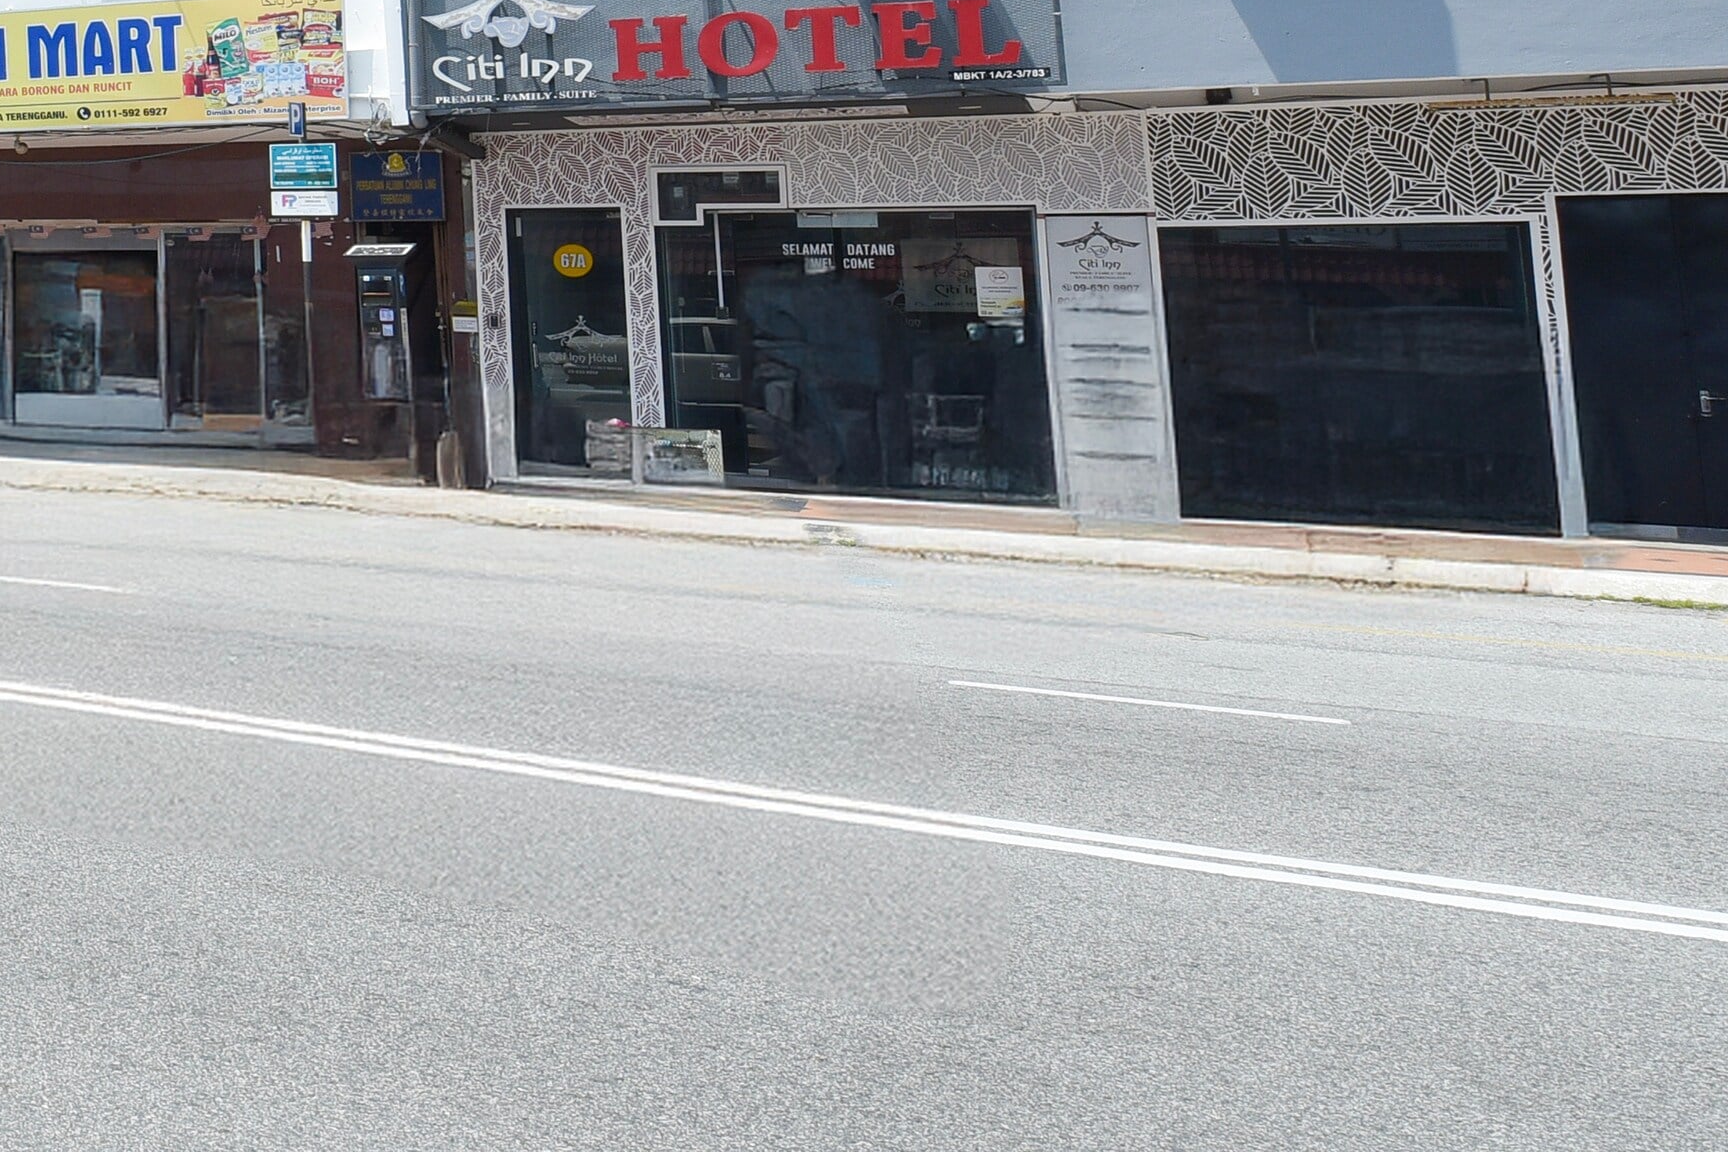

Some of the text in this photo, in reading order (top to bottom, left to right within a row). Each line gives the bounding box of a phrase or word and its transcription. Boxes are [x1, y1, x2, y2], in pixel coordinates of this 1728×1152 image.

[214, 29, 237, 42] MILO
[27, 15, 182, 80] MART
[432, 52, 593, 92] Citi Inn
[953, 69, 1045, 81] MBKT 1A/2-3/783
[313, 75, 337, 85] BOH
[22, 84, 65, 96] BORONG
[68, 84, 89, 93] DAN
[93, 81, 133, 92] RUNCIT
[435, 89, 597, 104] PREMIER FAMILY SUITE
[6, 111, 68, 121] TERENGGANU.
[94, 108, 140, 119] 0111-592
[143, 107, 168, 117] 6927
[206, 108, 235, 116] Dimiliki
[237, 107, 256, 115] Oleh
[291, 104, 301, 134] P
[782, 243, 895, 256] SELAMAT DATANG
[560, 253, 587, 268] 67A
[843, 258, 875, 269] COME
[1078, 258, 1121, 271] Citi Inn
[935, 283, 960, 297] Citi
